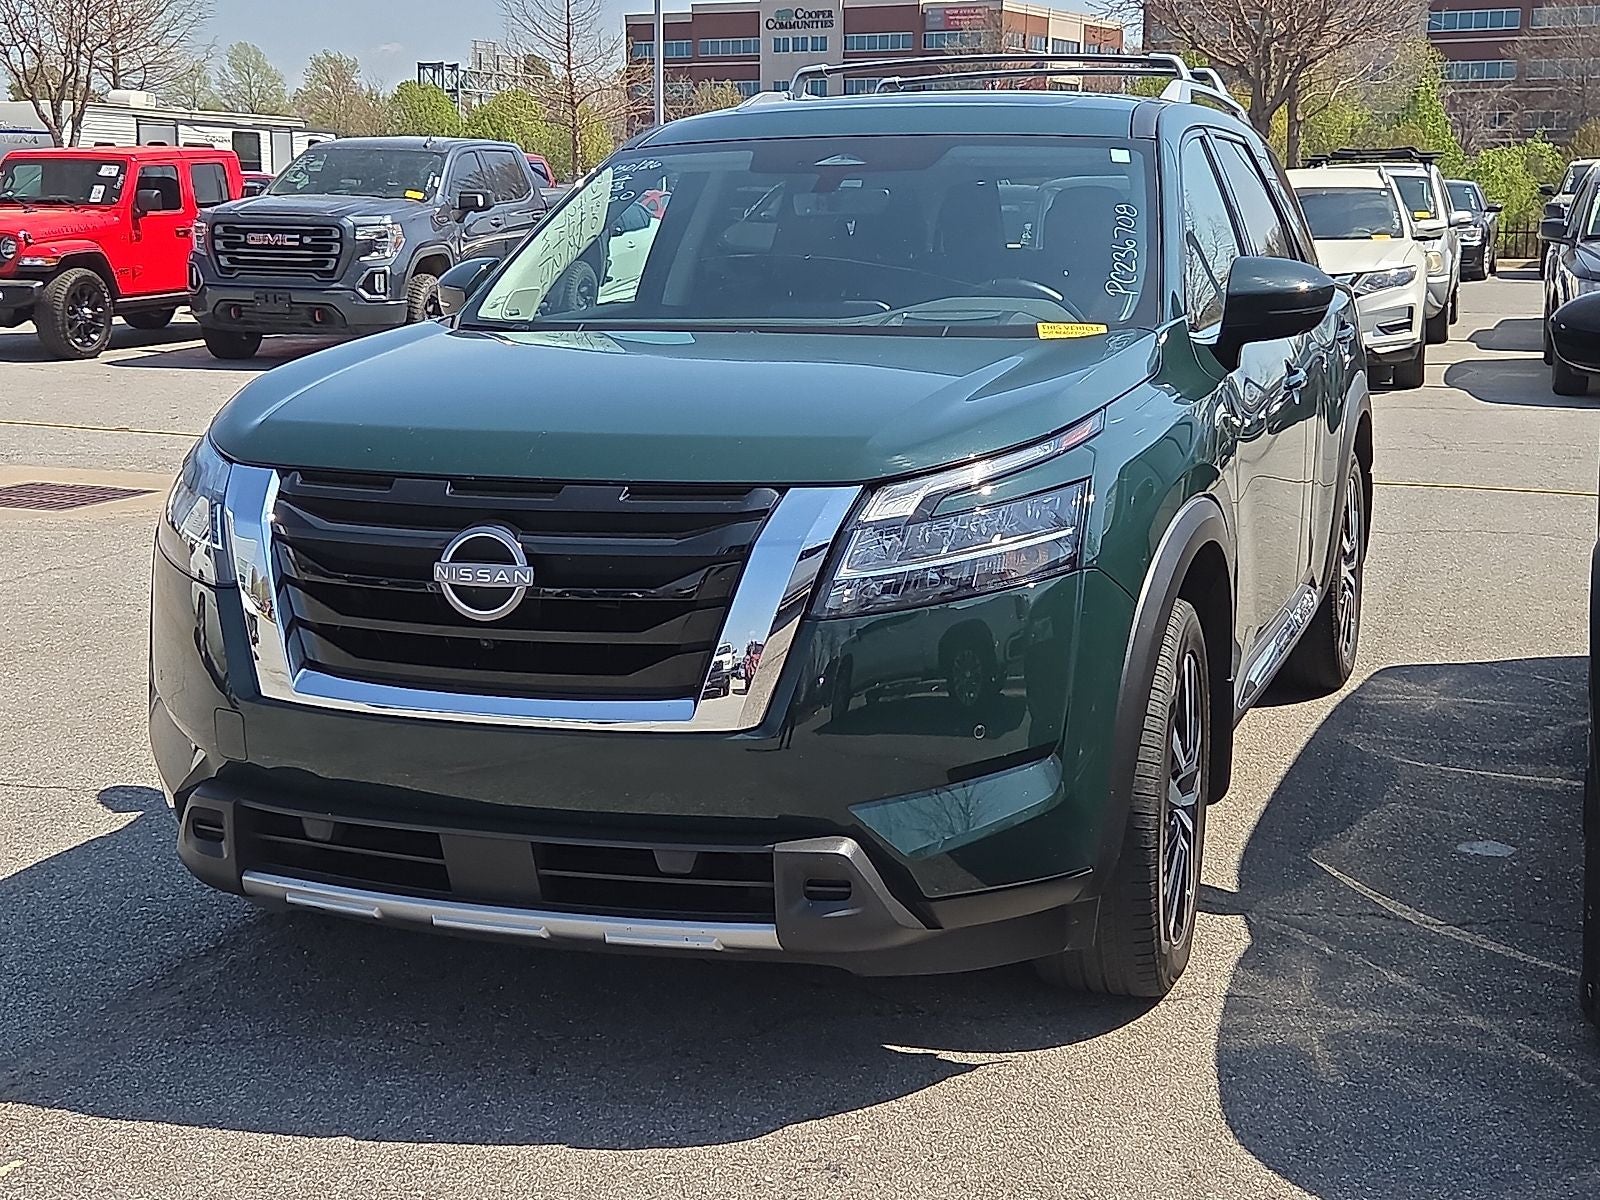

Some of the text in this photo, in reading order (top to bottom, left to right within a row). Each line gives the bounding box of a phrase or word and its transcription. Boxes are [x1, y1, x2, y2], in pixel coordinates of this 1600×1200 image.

[794, 7, 834, 19] COOPER
[765, 18, 835, 30] COMMUNITIES
[246, 232, 300, 246] GMC
[435, 564, 531, 583] NISSAN
